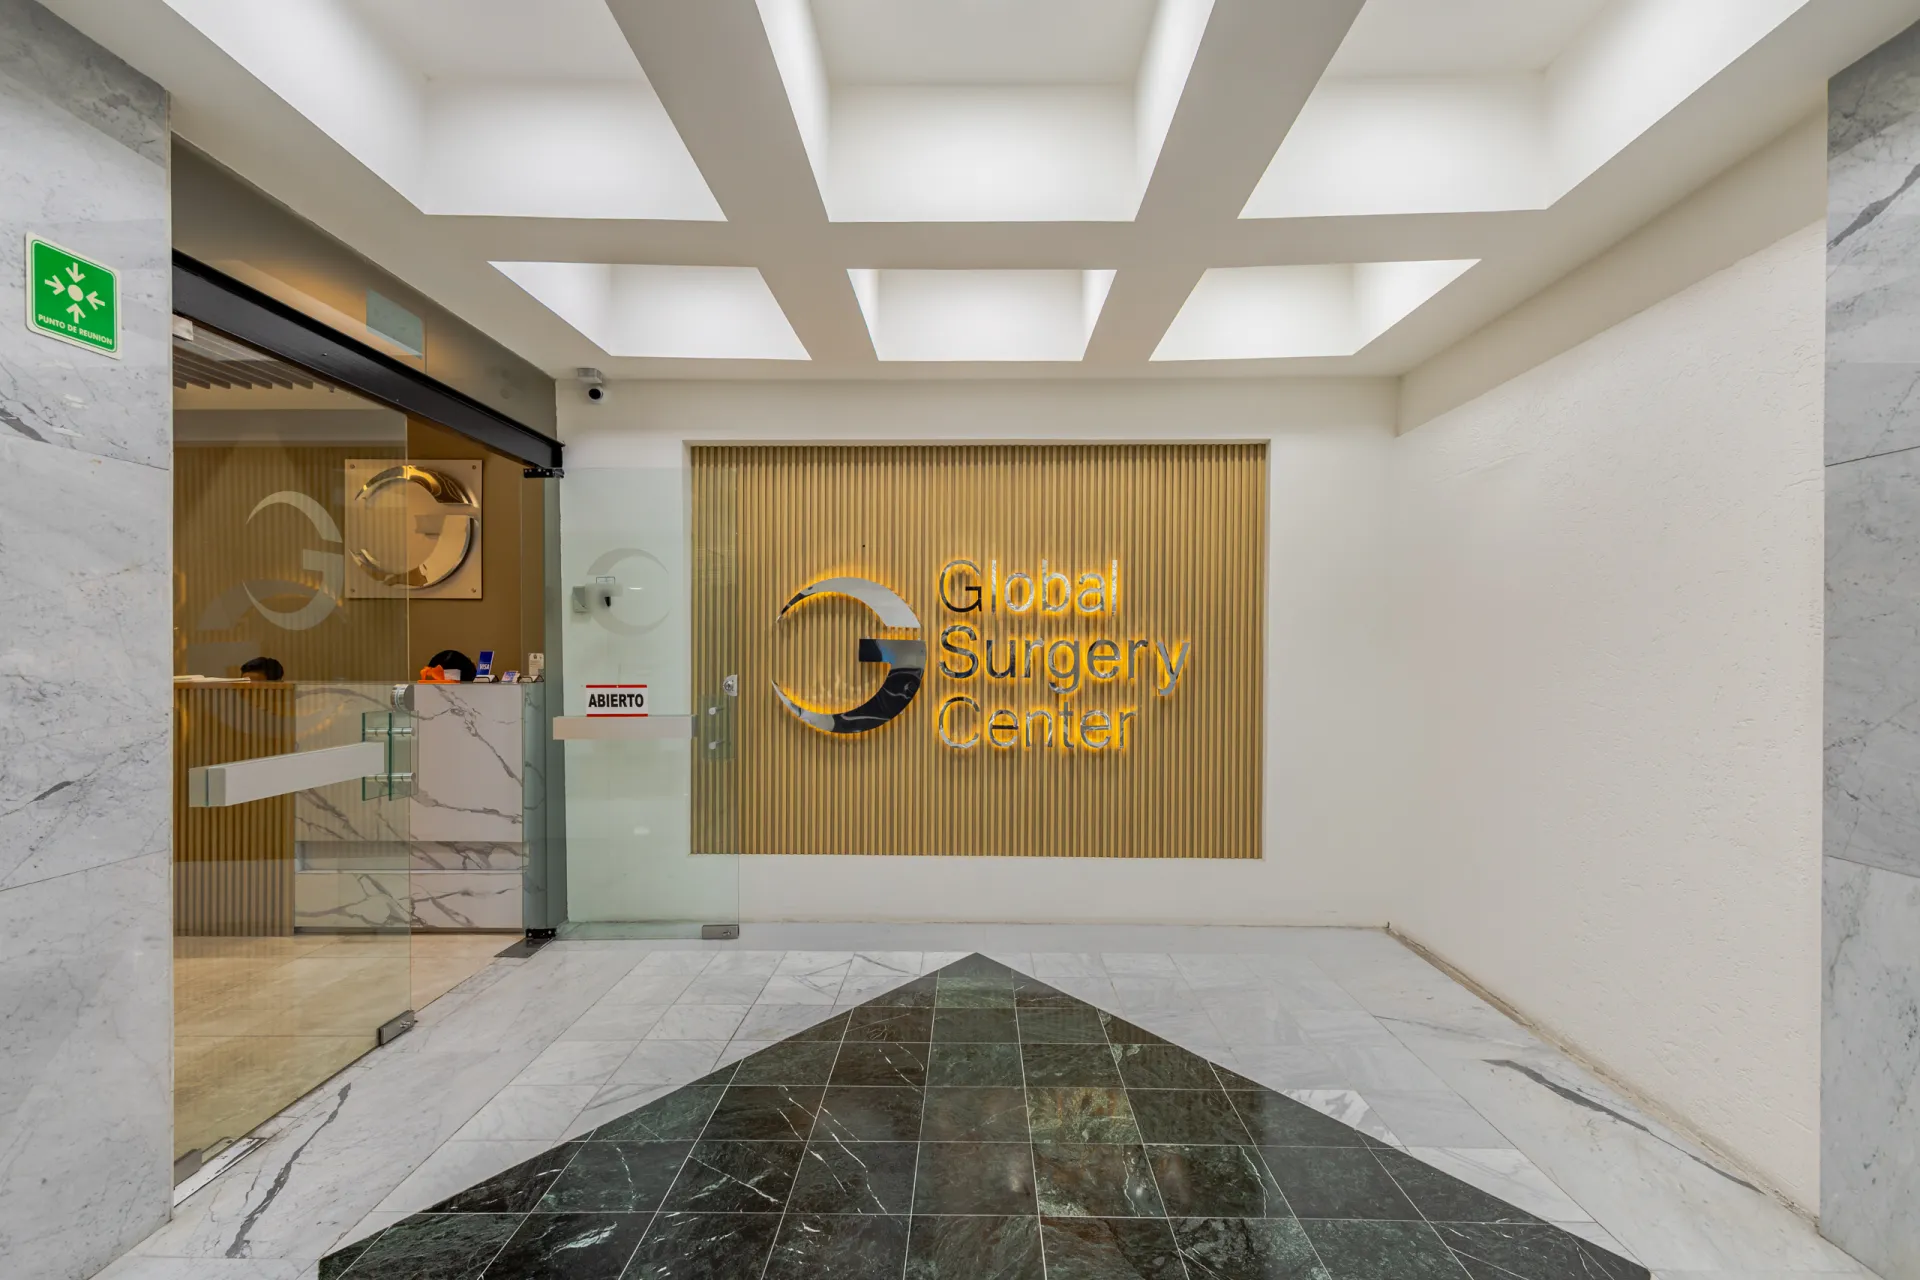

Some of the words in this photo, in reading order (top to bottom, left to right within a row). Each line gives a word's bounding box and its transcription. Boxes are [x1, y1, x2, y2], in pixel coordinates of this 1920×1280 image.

[38, 314, 65, 328] PUNTO
[67, 324, 77, 333] DE
[79, 328, 112, 345] REUNION
[938, 558, 1119, 617] Global
[938, 624, 1191, 697] Surgery
[588, 693, 644, 708] ABIERTO
[938, 696, 1138, 750] Center
